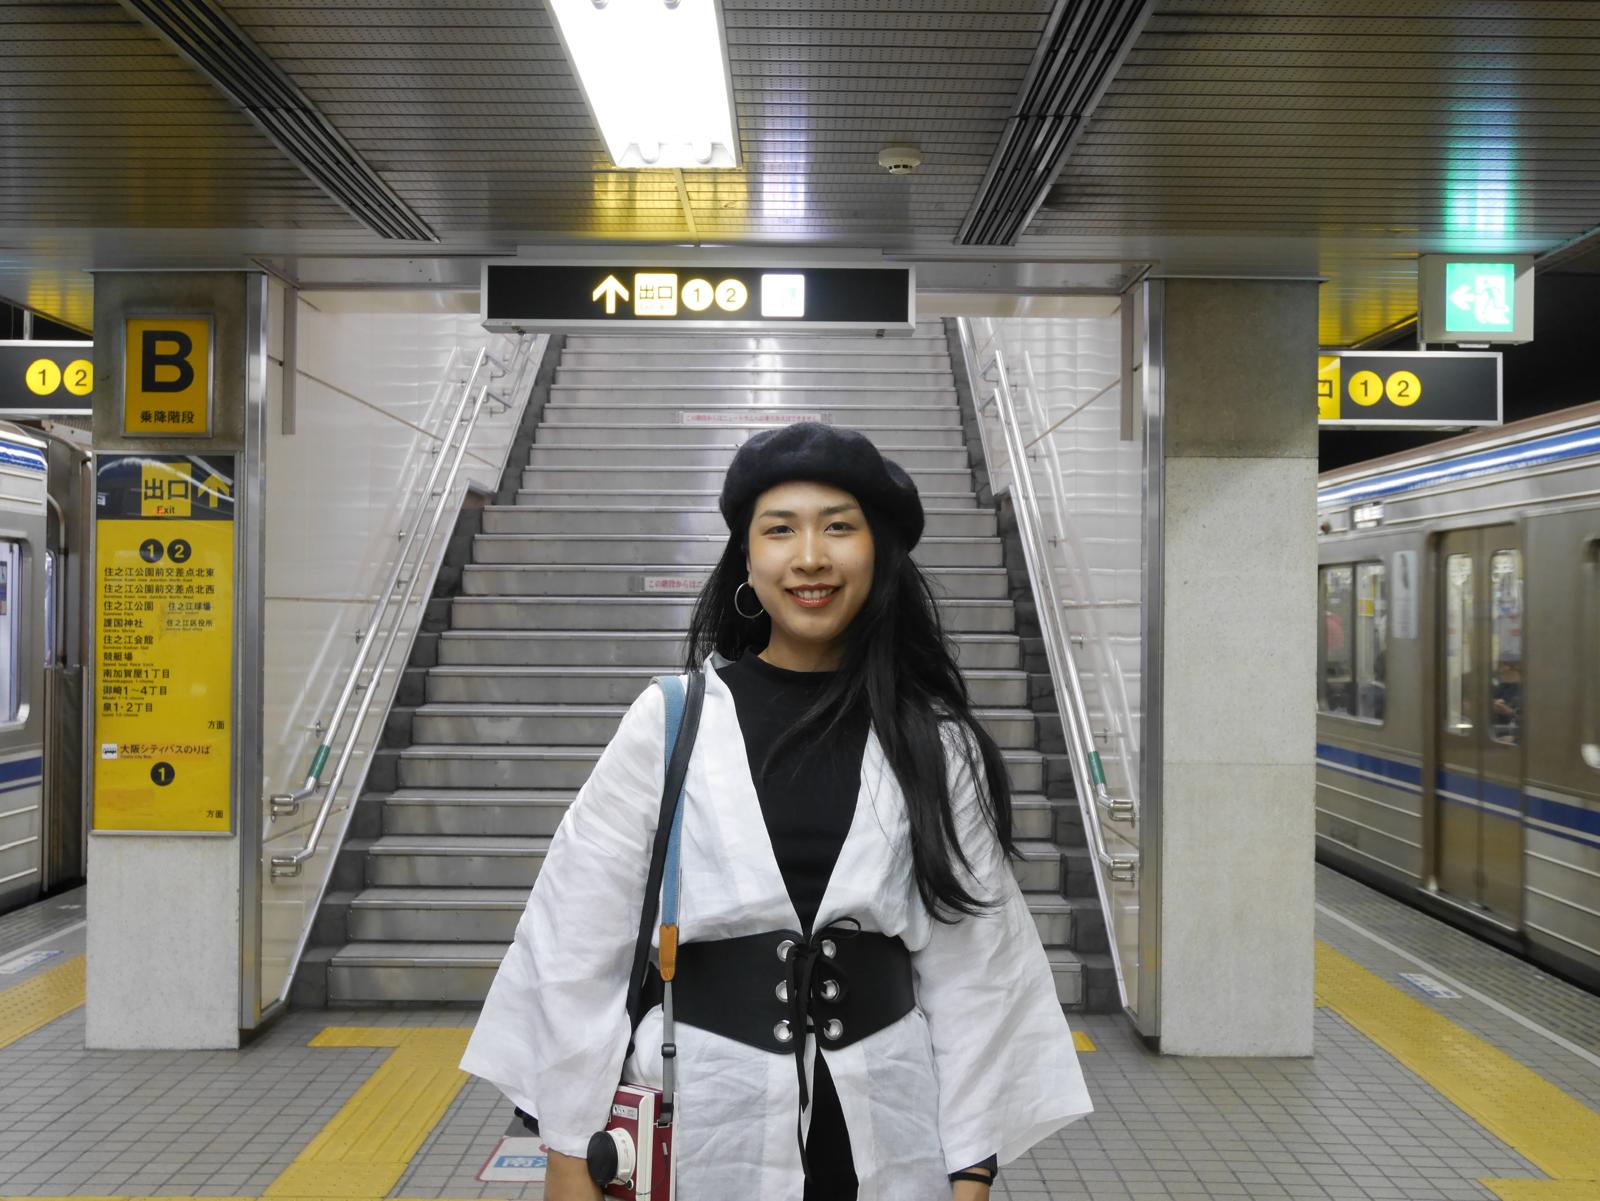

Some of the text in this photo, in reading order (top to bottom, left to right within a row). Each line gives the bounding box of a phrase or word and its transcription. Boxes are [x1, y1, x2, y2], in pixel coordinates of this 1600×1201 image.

[639, 284, 673, 300] 出口
[141, 330, 195, 393] B
[140, 411, 195, 424] 乗降階段
[143, 478, 190, 501] 出口
[156, 505, 175, 515] Exit
[103, 601, 154, 611] 住之江公園
[103, 618, 144, 629] 護国神社
[103, 635, 154, 645] 住之江会館
[207, 720, 224, 730] 方面
[120, 744, 212, 755] 大阪シティバスのりば
[205, 810, 224, 819] 方面
